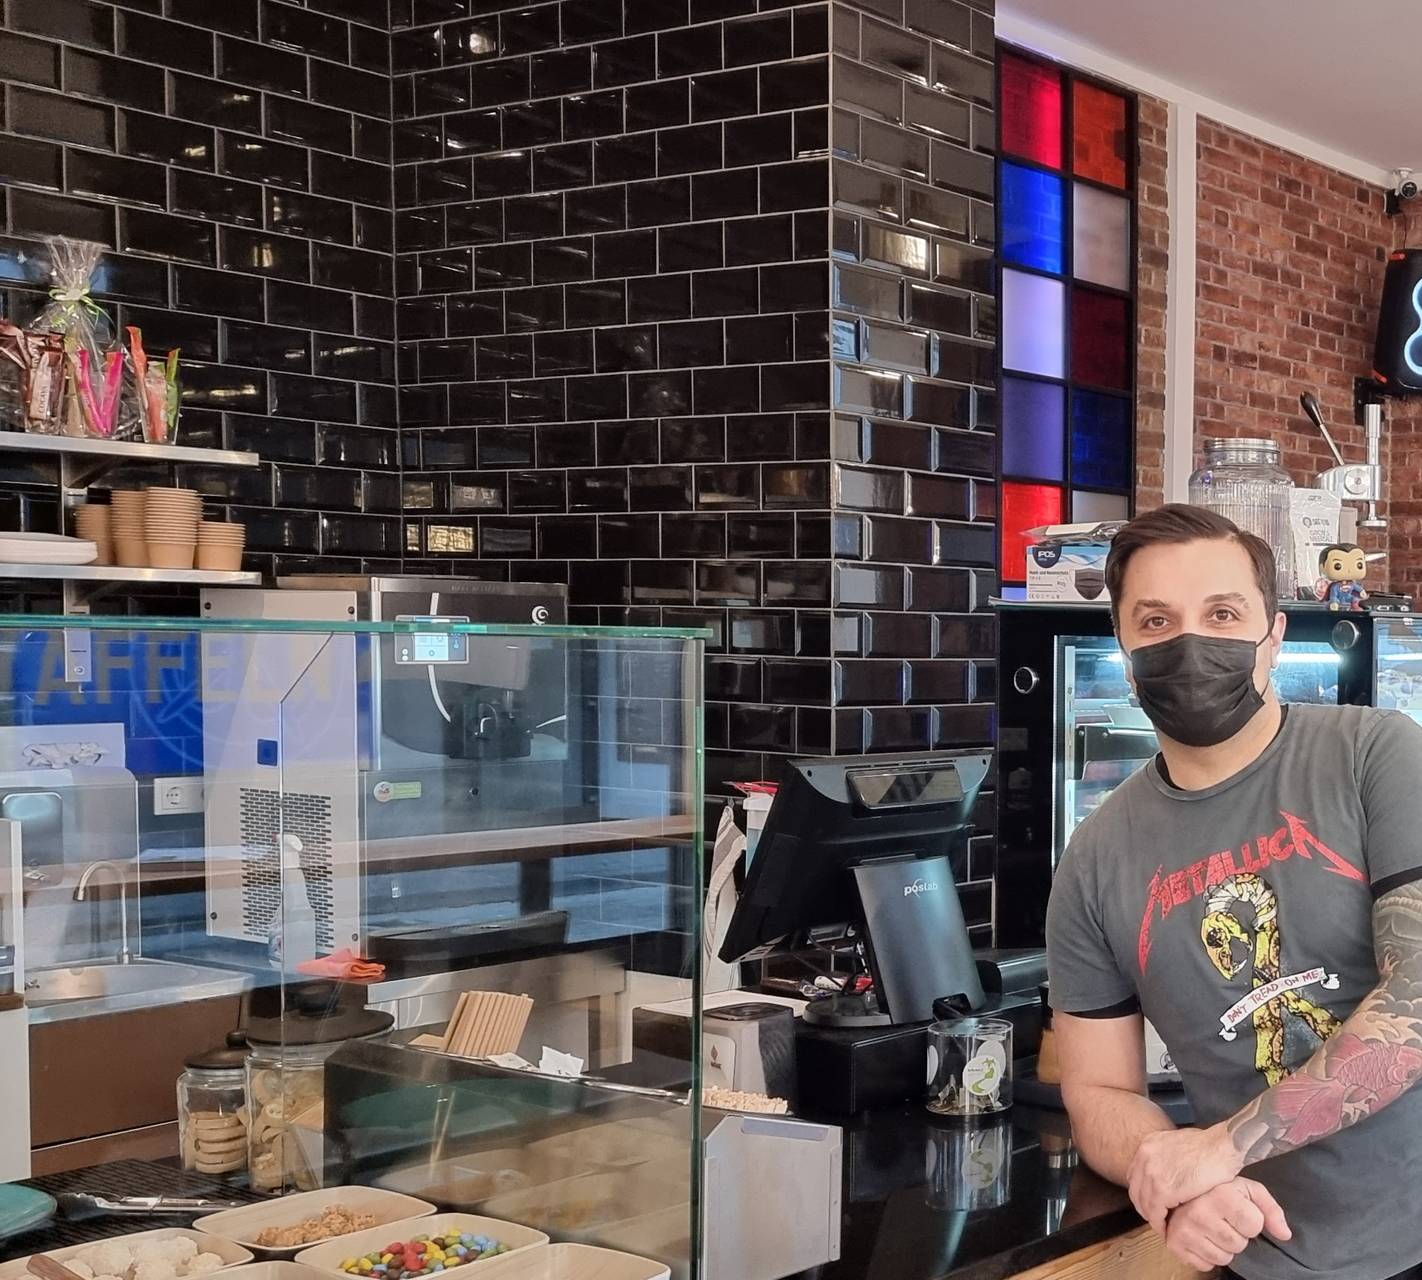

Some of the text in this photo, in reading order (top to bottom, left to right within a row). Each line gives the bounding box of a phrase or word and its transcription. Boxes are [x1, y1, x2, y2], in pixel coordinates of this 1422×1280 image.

[903, 881, 938, 896] poslab
[1138, 809, 1368, 977] METALLICA
[1227, 970, 1319, 1023] DON'T TREAD ON ME
